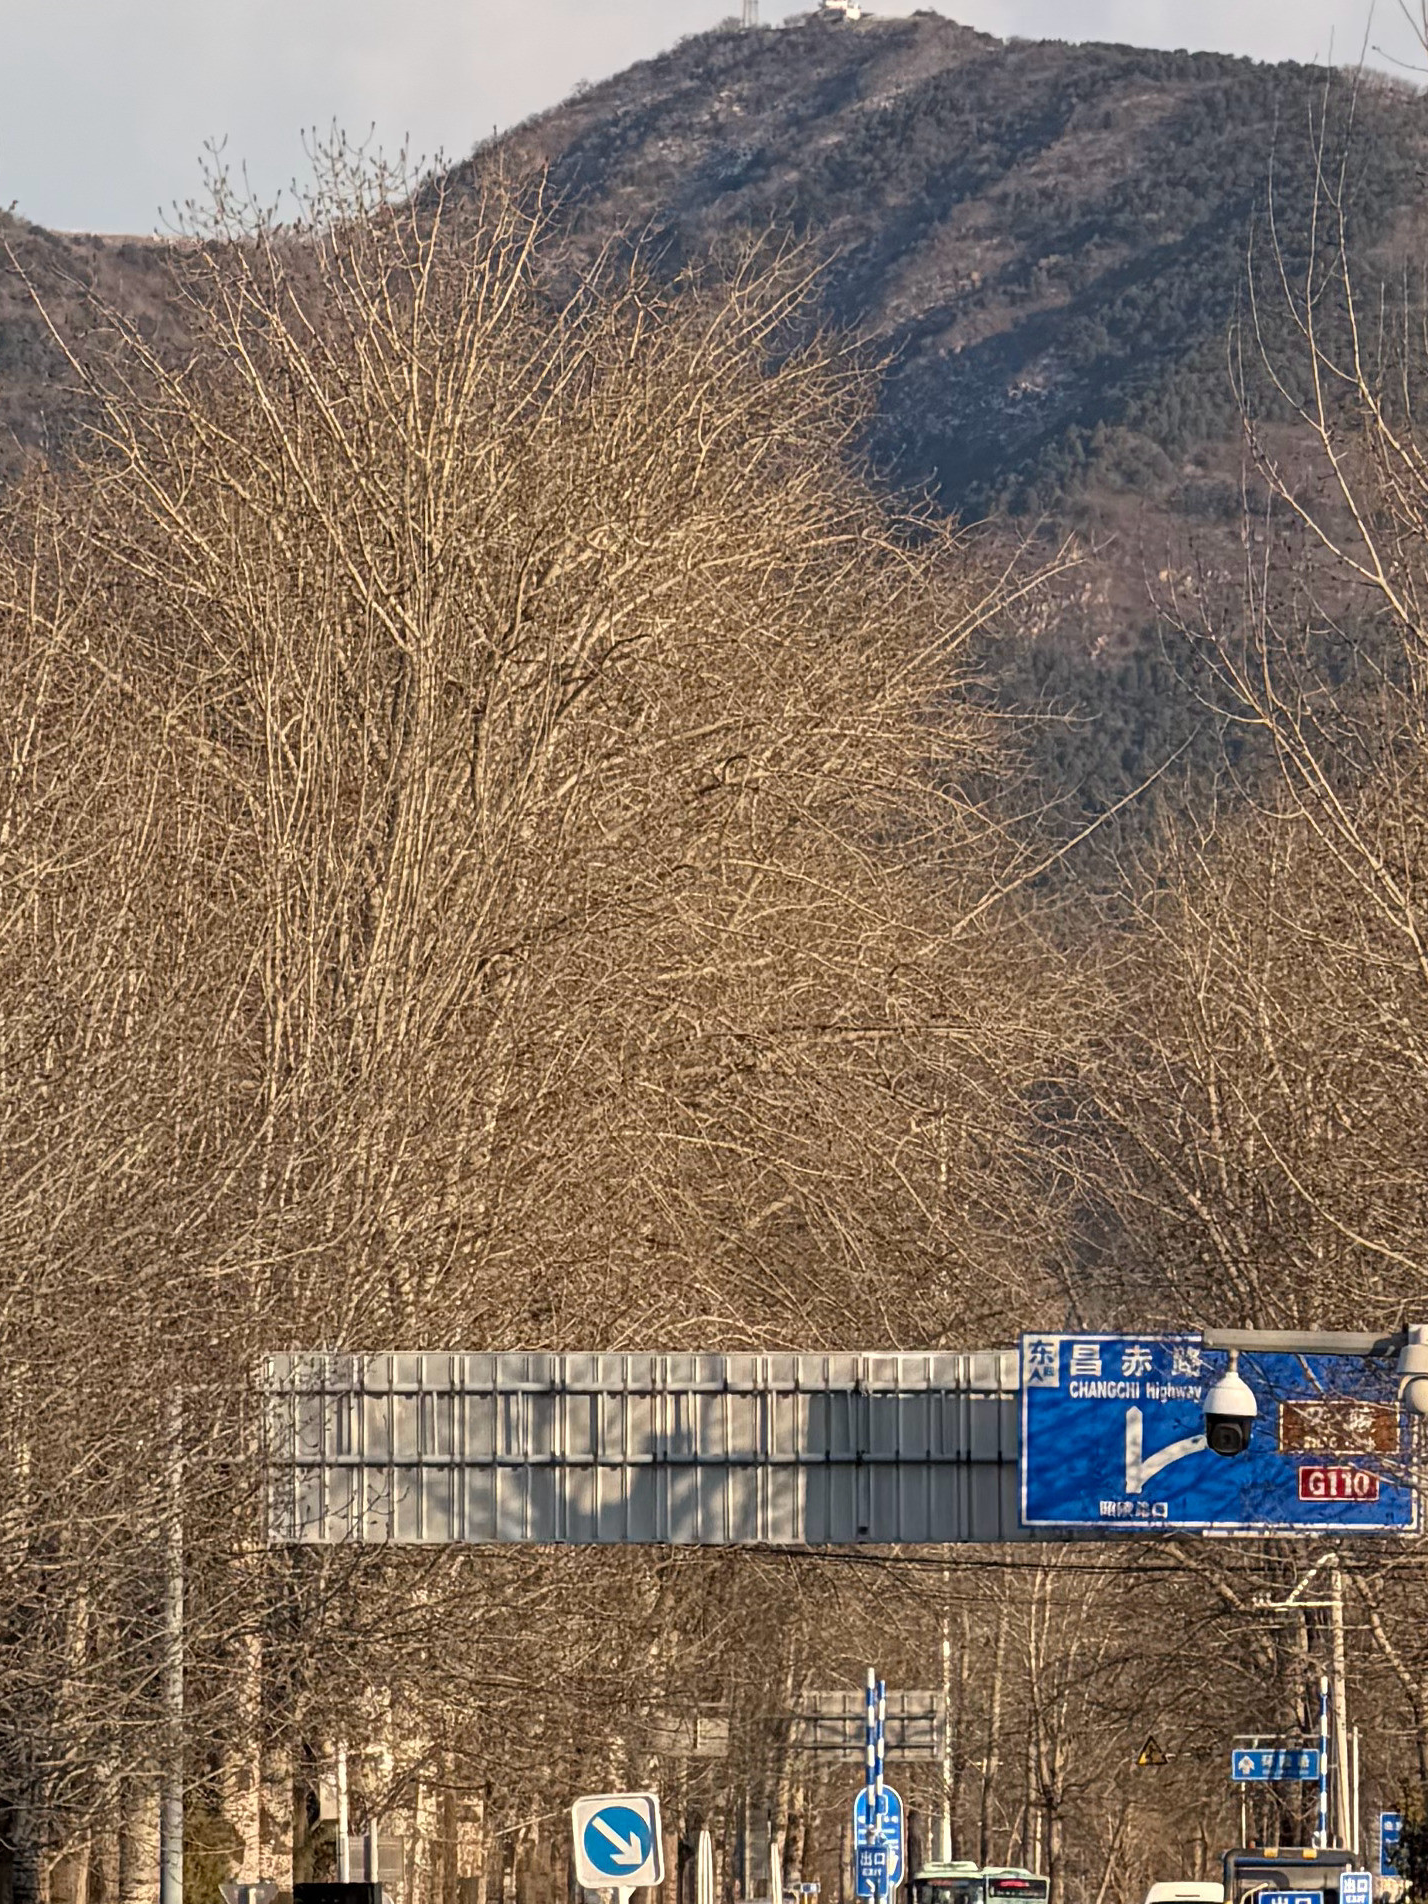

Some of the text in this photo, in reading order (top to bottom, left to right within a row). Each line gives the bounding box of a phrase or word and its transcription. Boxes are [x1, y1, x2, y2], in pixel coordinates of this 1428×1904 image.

[1069, 1381, 1140, 1399] CHANGCHI
[1308, 1471, 1371, 1497] G110
[860, 1851, 886, 1866] 出口
[1343, 1877, 1368, 1893] 出口
